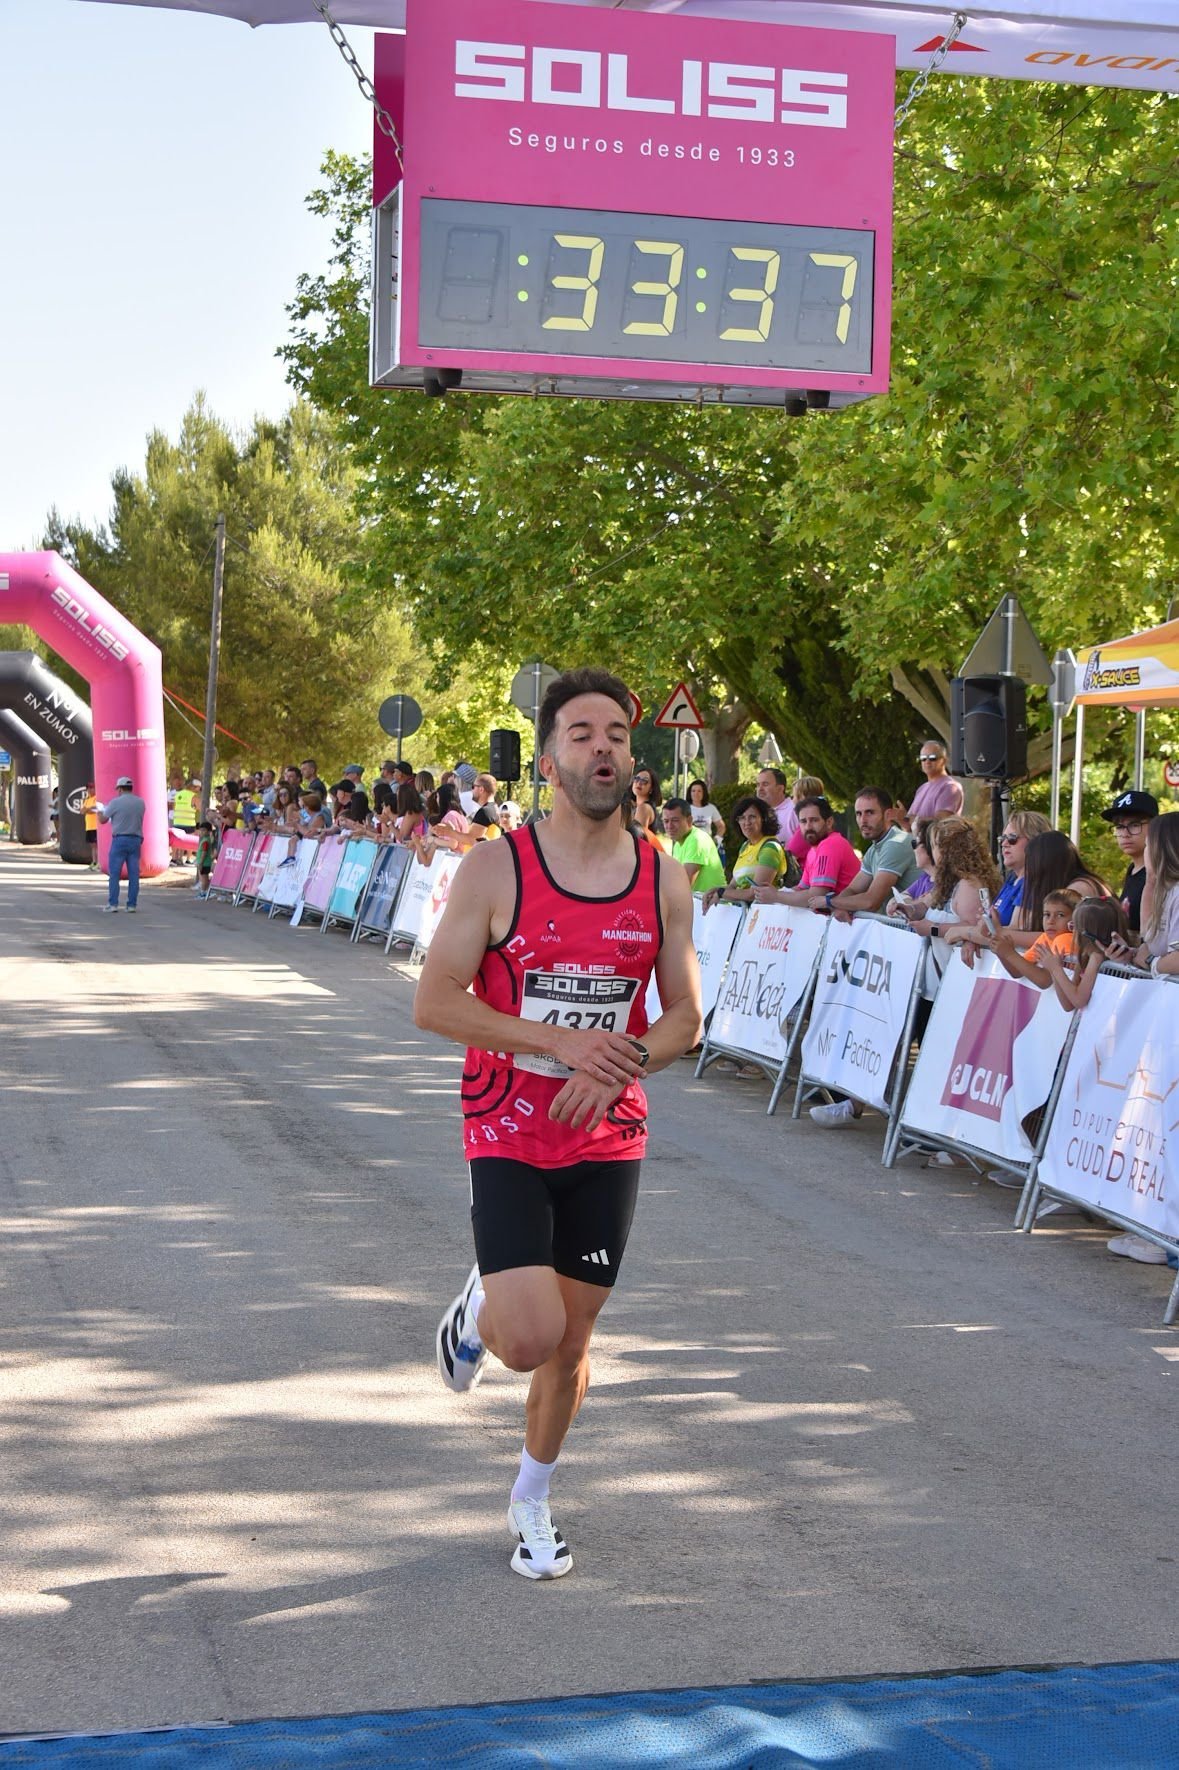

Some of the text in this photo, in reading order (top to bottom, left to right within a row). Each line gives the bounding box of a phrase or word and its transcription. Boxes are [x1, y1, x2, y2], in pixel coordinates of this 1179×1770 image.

[455, 40, 848, 129] SOLISS
[508, 127, 797, 168] Seguros desde 1933
[51, 586, 130, 662] SOLISS
[1091, 667, 1140, 688] X-SAUCE
[23, 692, 79, 745] EN ZUMOS
[602, 929, 652, 943] MANCHATHON
[553, 963, 617, 975] SOLISS
[535, 975, 628, 996] SOLISS
[541, 1009, 617, 1033] 4379
[1128, 1157, 1166, 1202] REAL
